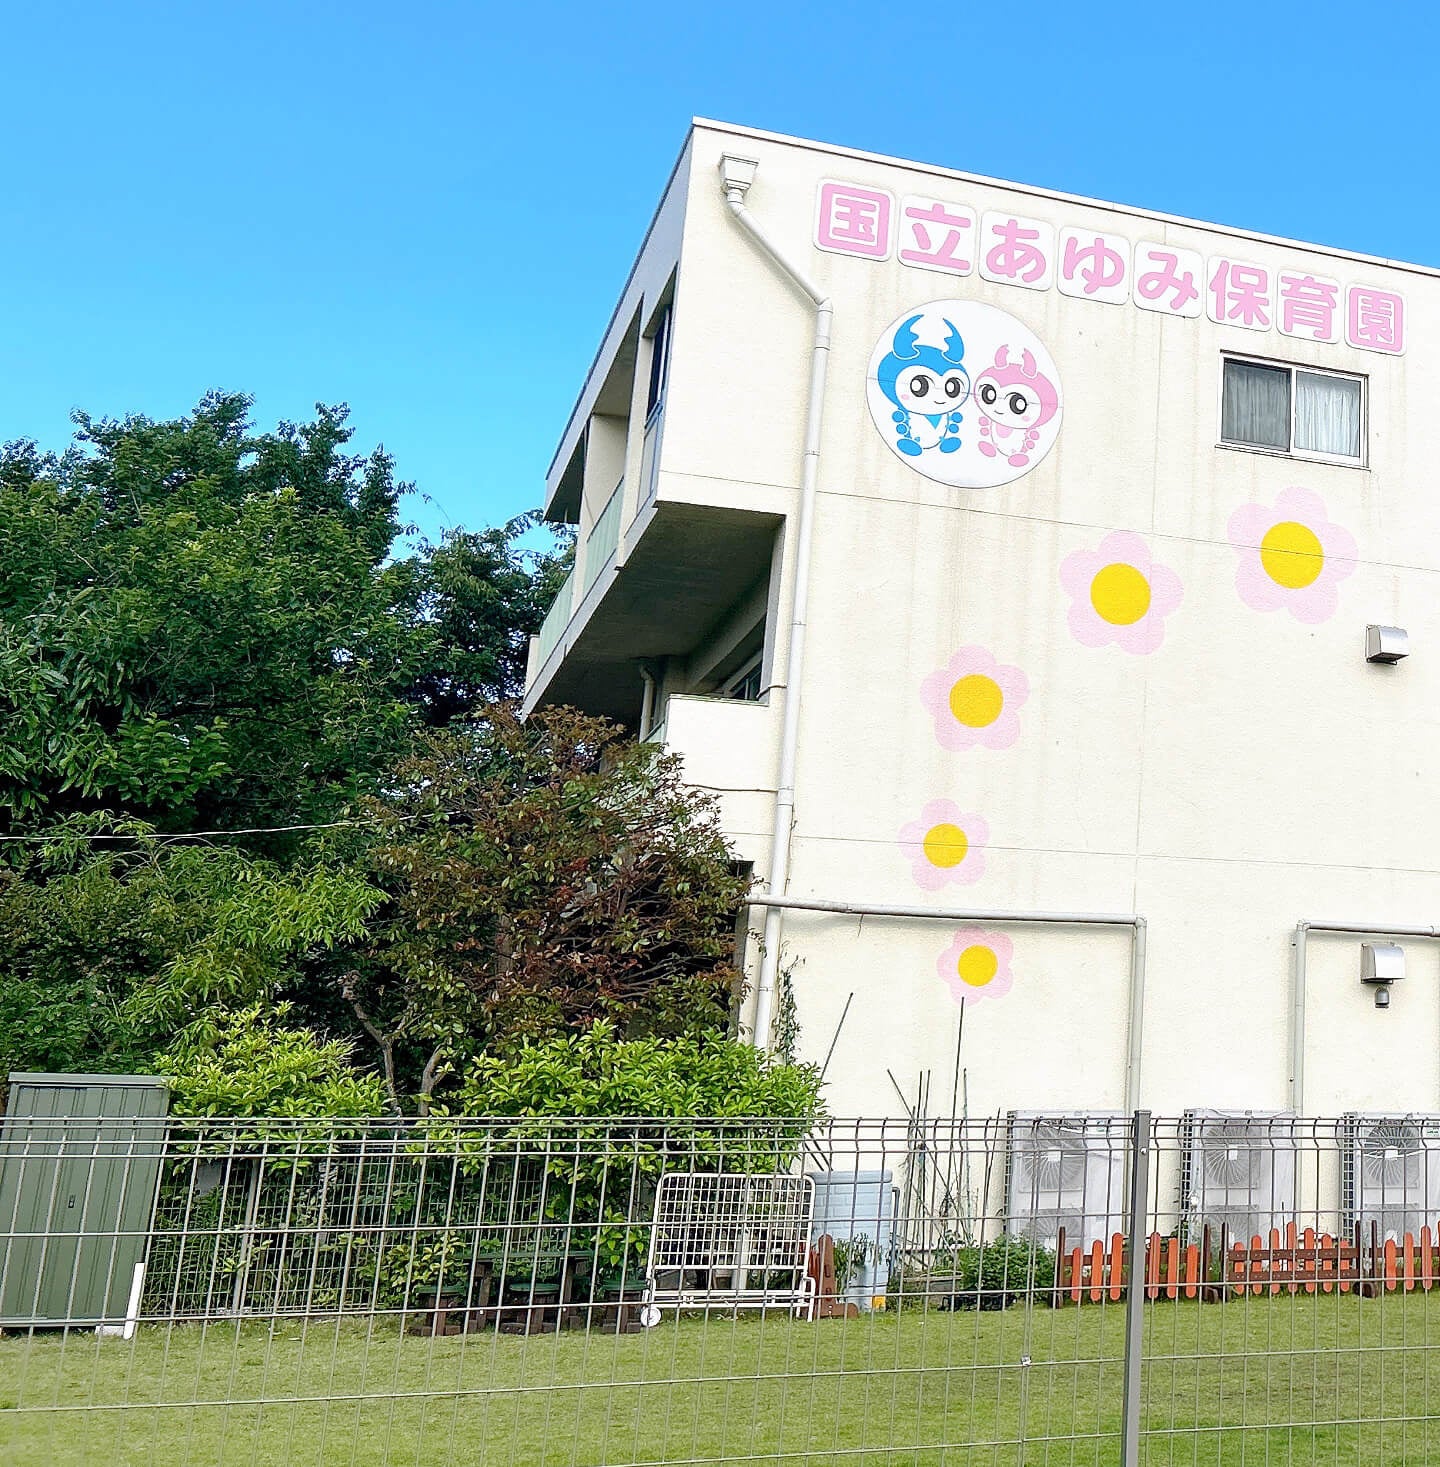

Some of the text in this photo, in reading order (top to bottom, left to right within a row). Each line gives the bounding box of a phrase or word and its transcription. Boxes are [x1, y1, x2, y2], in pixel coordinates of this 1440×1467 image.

[819, 182, 1404, 353] 国立あゆみ保育園
